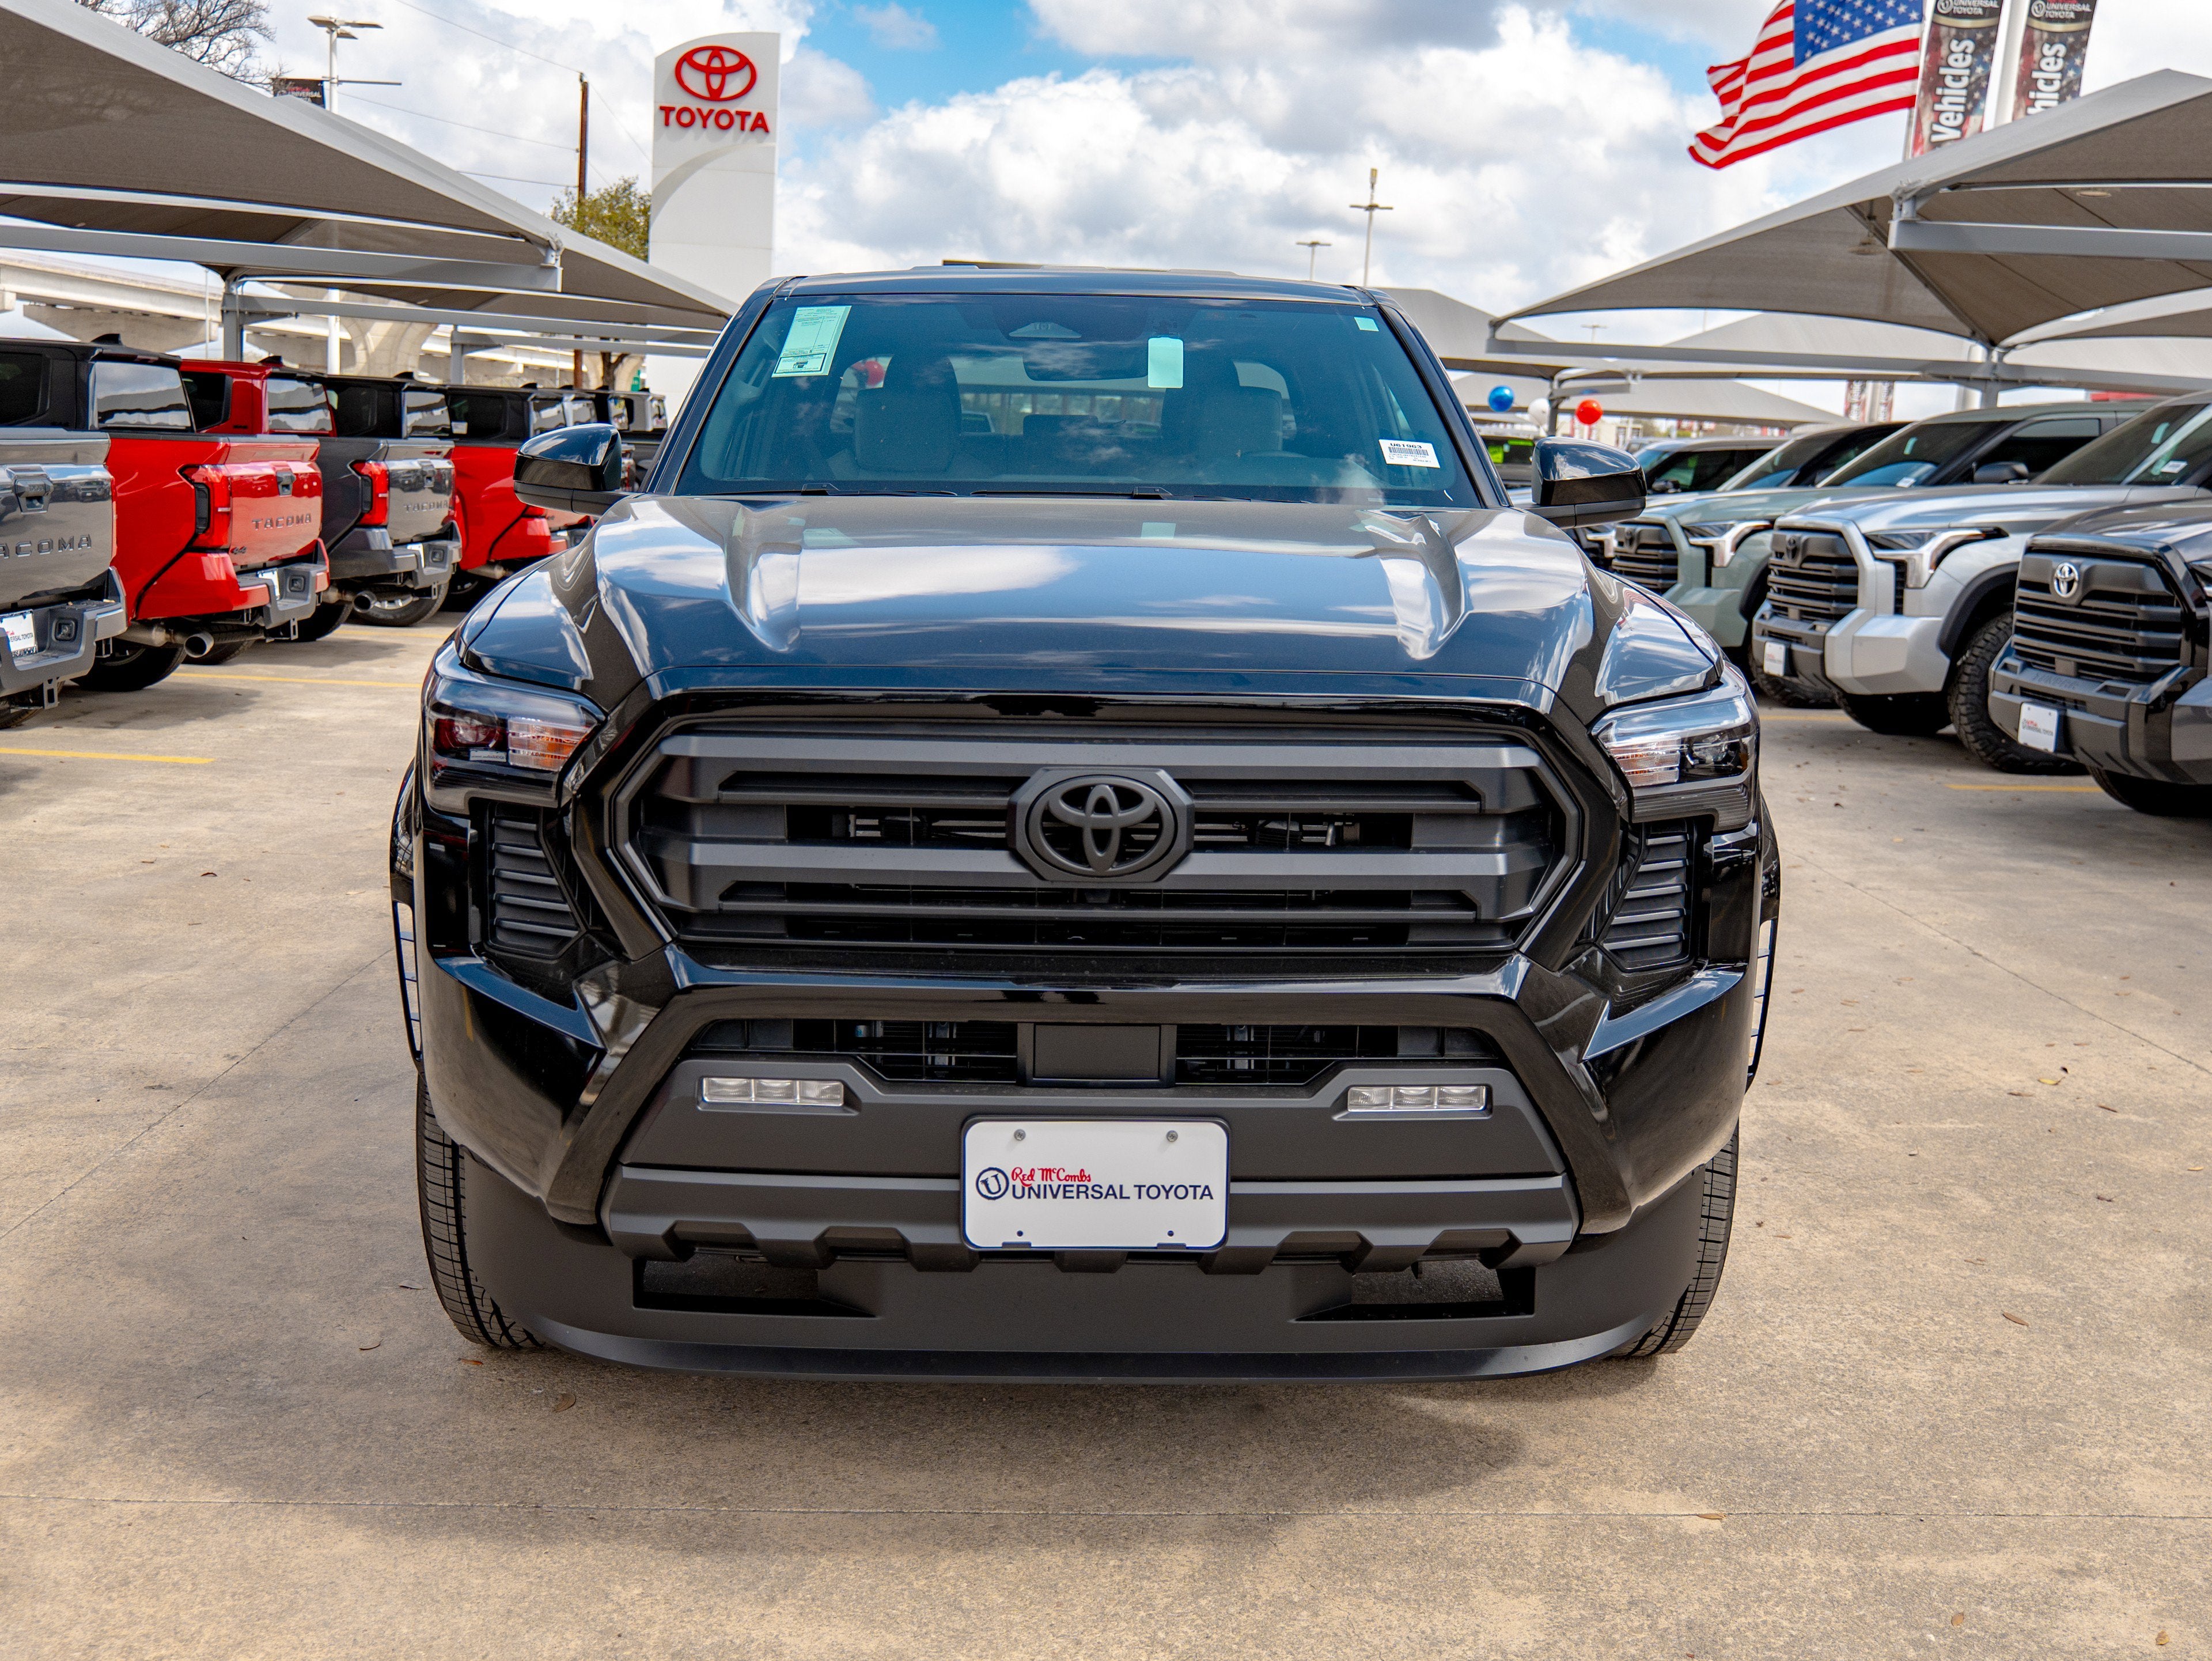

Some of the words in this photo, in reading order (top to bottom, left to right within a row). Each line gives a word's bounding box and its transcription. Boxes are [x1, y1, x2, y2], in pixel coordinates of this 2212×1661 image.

[1953, 0, 1999, 8] UNIVERSAL
[1953, 6, 1983, 15] TOYOTA
[2047, 2, 2092, 12] UNIVERSAL
[2045, 10, 2075, 19] TOYOTA
[1930, 39, 1975, 142] Vehicles
[660, 106, 769, 133] TOYOTA
[404, 500, 448, 513] TACOMA
[252, 513, 312, 531] TACOMA
[1012, 1167, 1035, 1187] Red
[1037, 1167, 1091, 1183] McCombs
[1012, 1184, 1130, 1200] UNIVERSAL
[1134, 1185, 1214, 1200] TOYOTA
